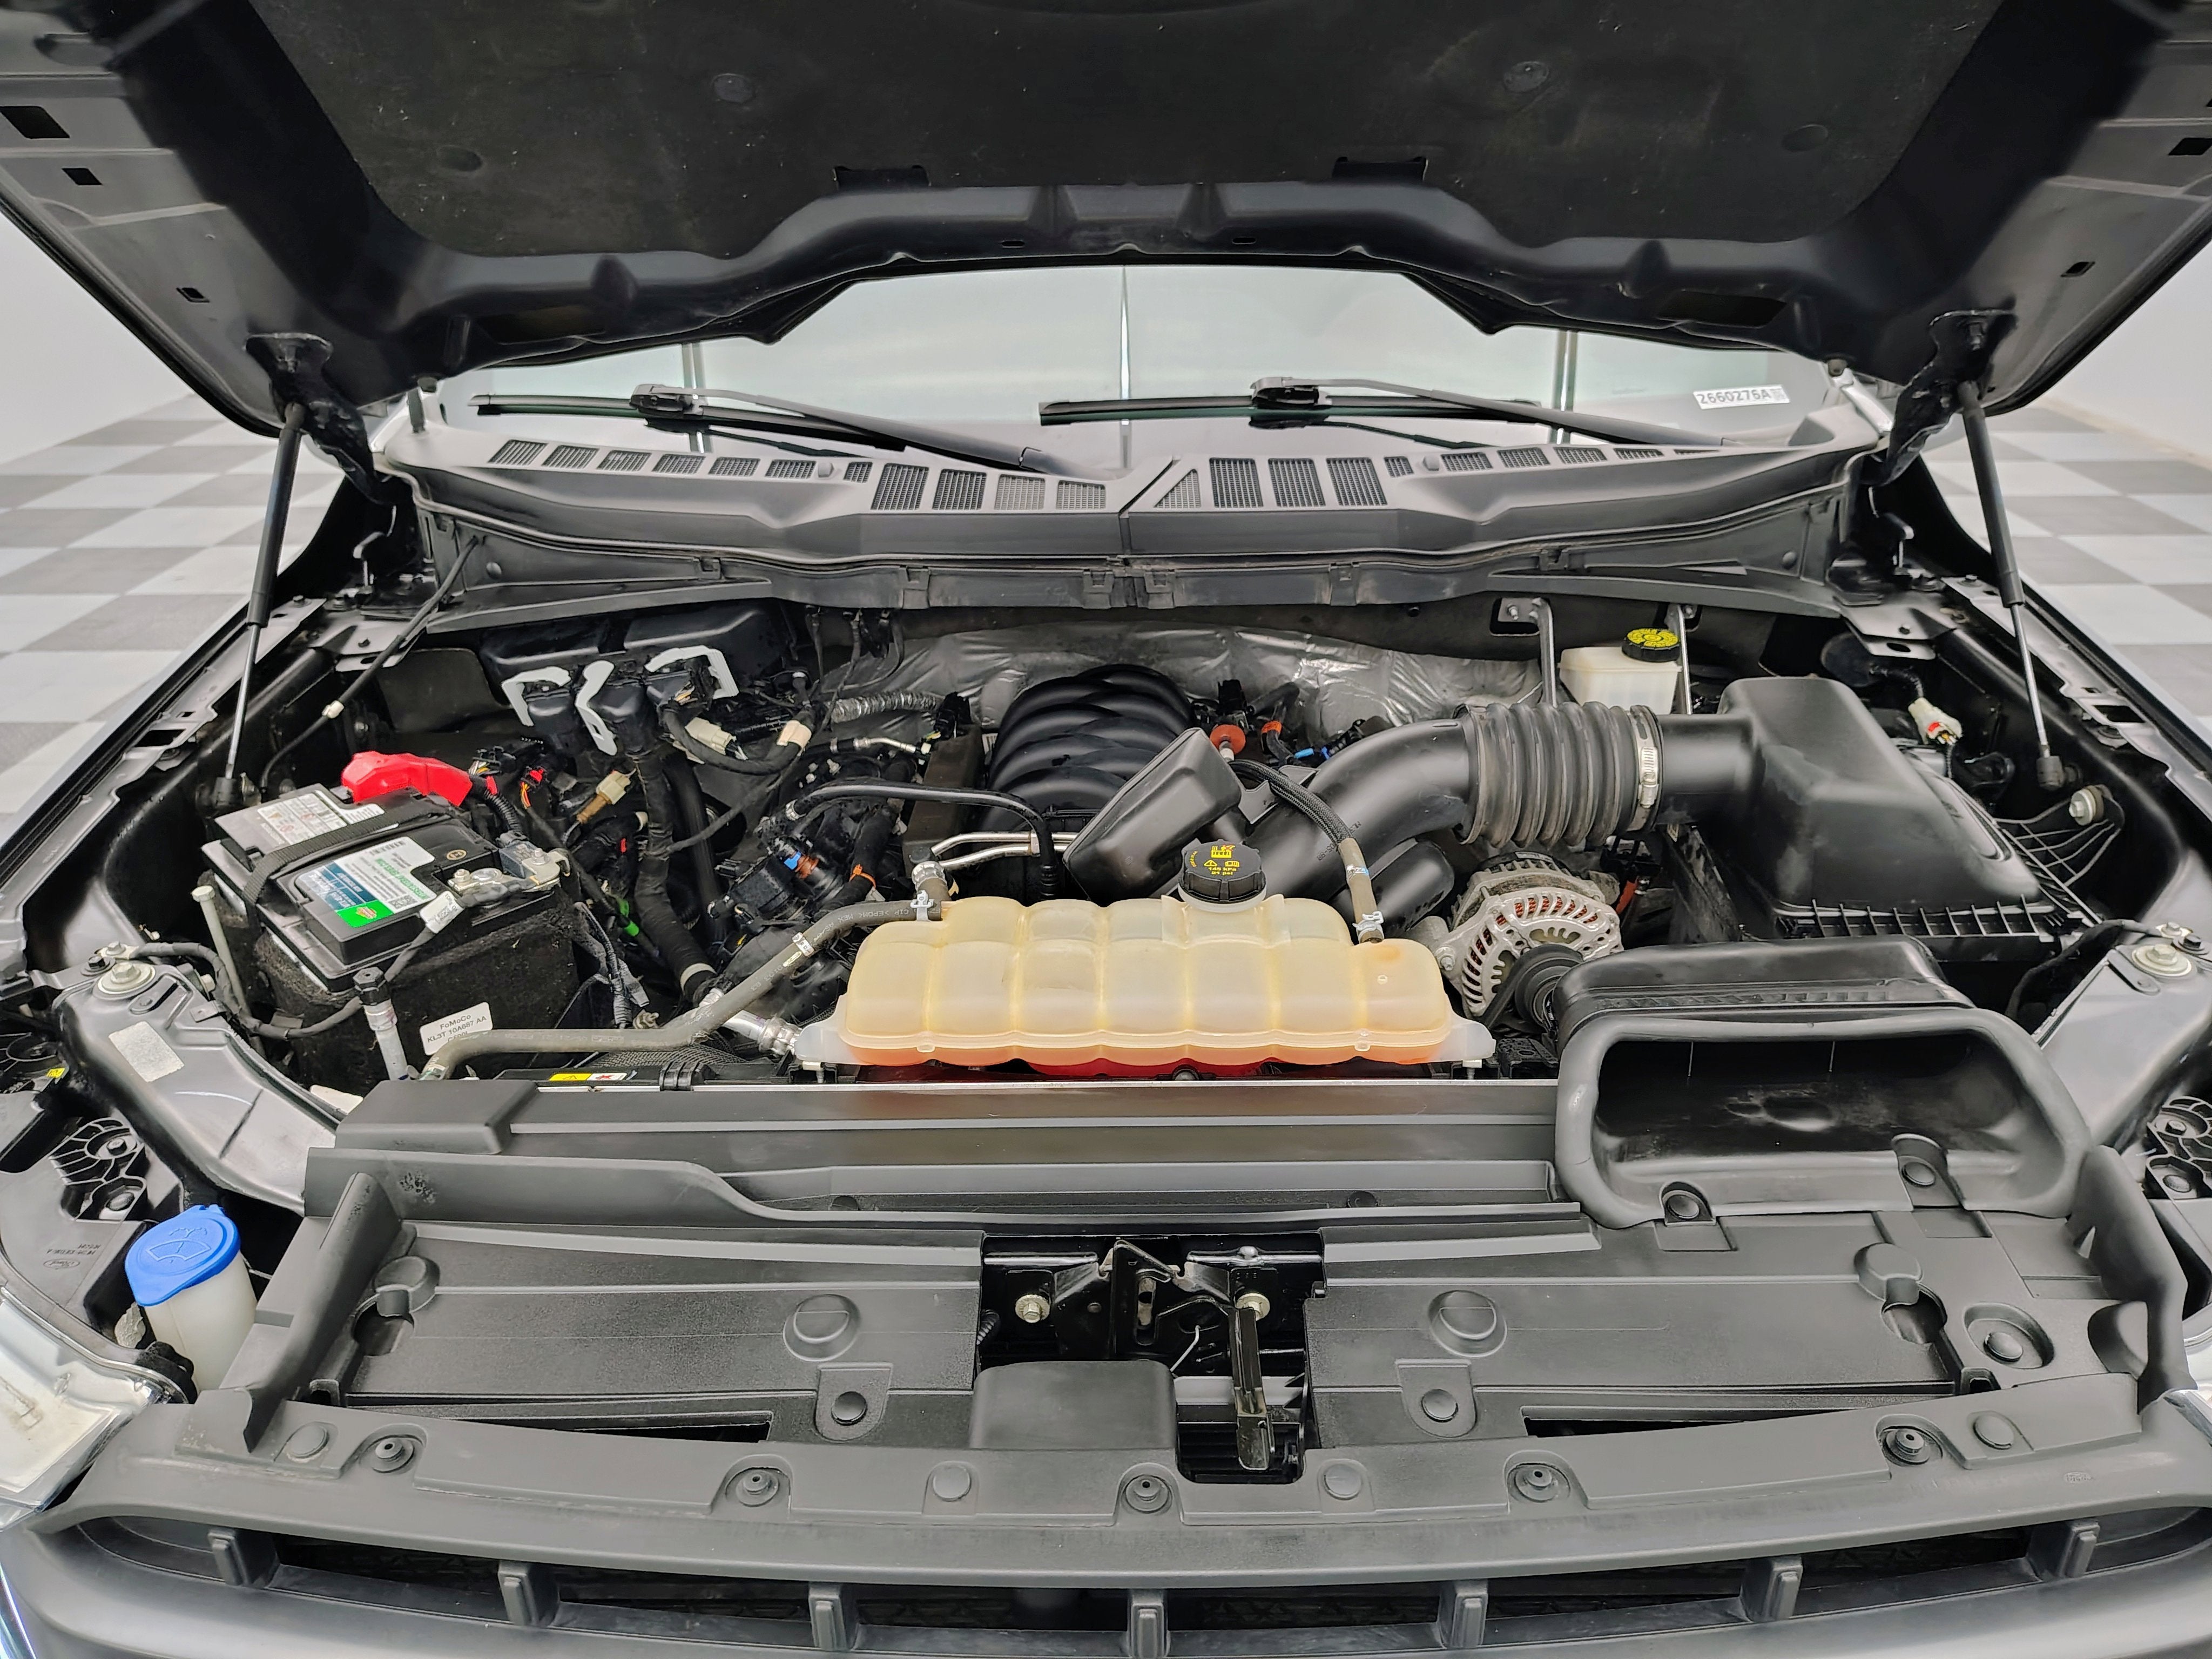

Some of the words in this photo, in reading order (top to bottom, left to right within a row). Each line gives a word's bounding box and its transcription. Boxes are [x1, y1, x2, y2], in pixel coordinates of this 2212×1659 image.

[1696, 389, 1771, 404] 2660276A
[440, 1015, 471, 1029] FoMoCo
[427, 1031, 446, 1042] KL3T
